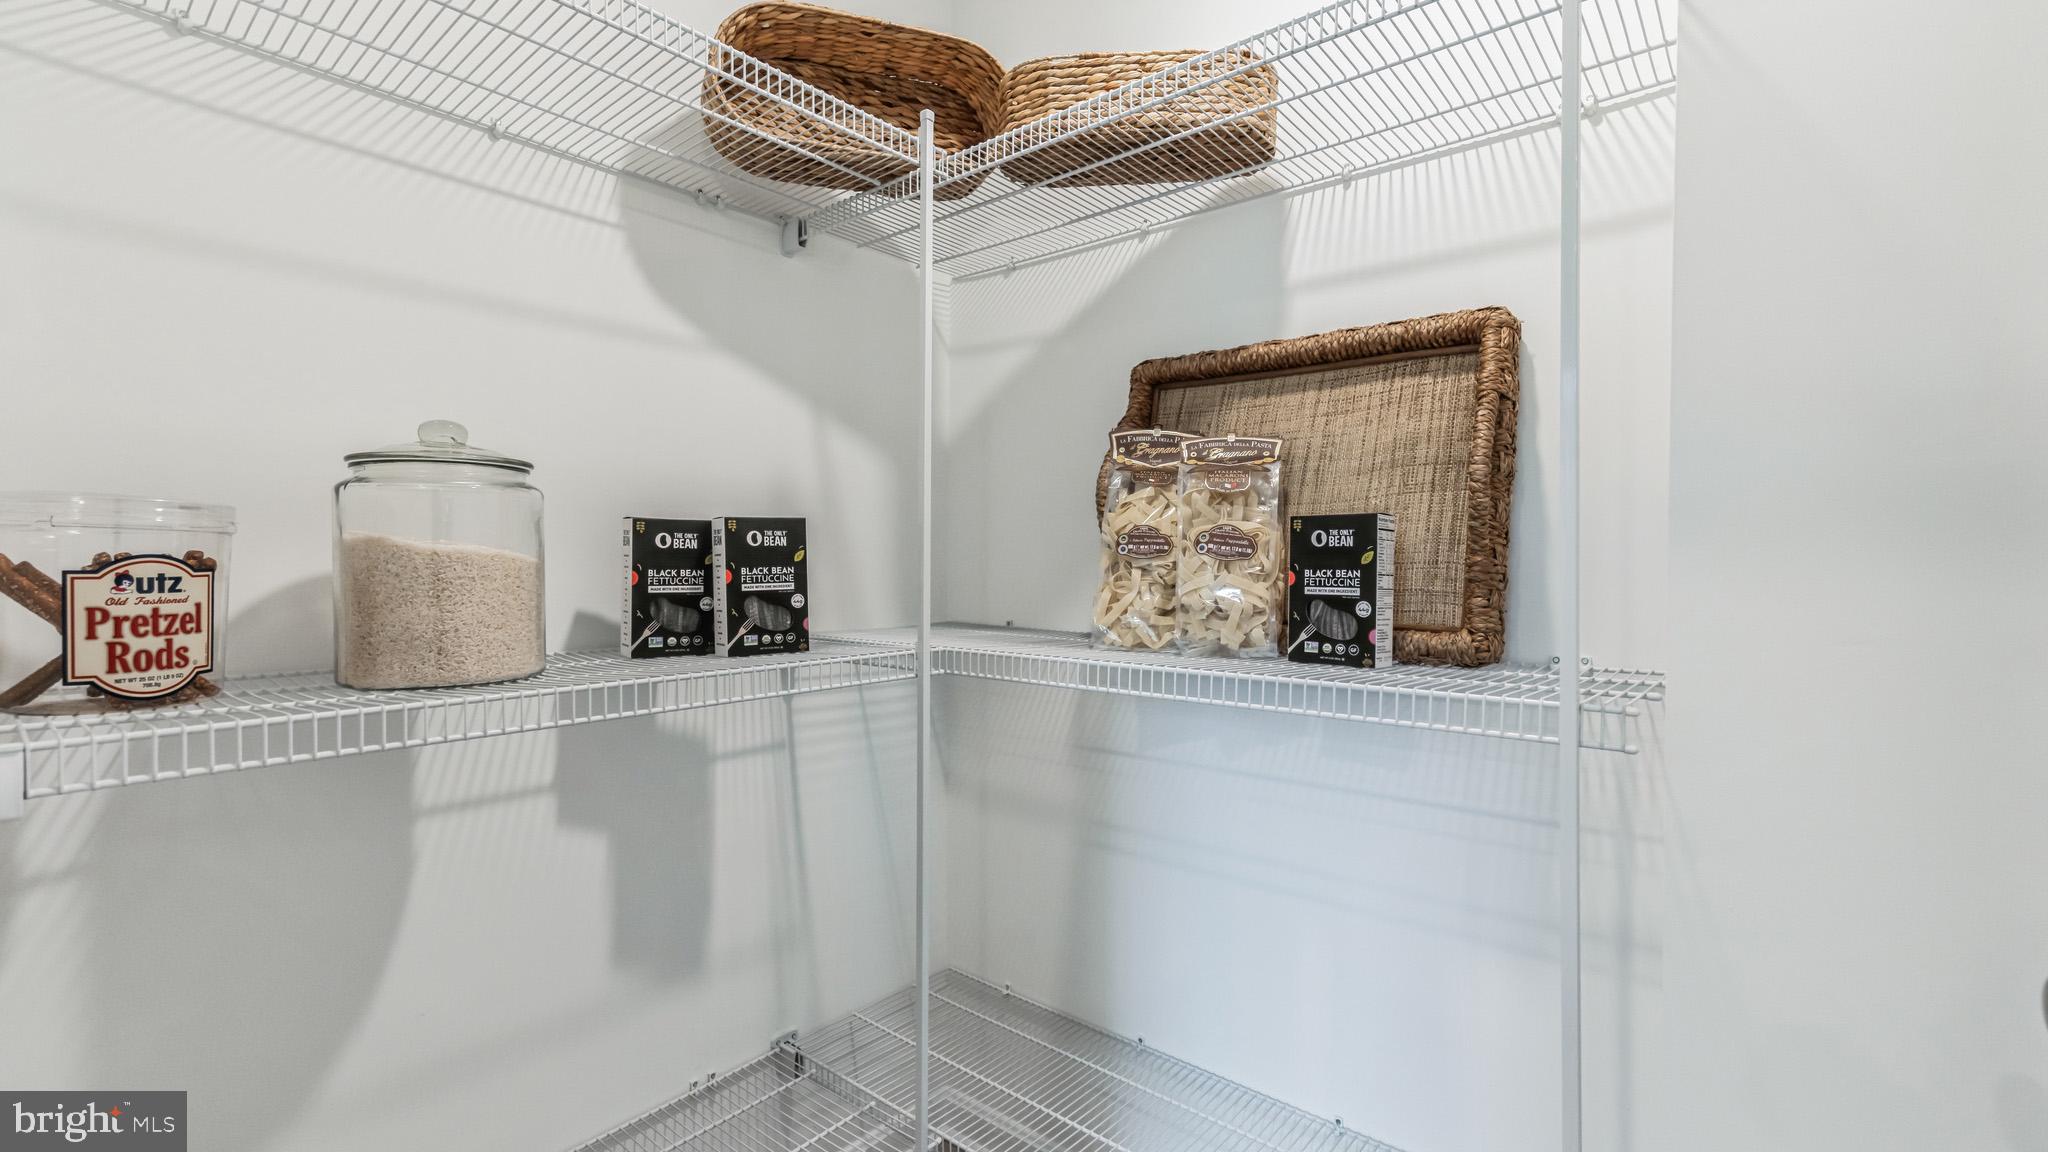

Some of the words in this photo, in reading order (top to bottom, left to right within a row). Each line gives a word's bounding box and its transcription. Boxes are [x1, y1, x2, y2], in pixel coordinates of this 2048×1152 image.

[673, 538, 698, 549] BEAN
[764, 536, 787, 546] BEAN
[1328, 536, 1354, 546] BEAN
[648, 569, 678, 577] BLACK
[680, 569, 704, 577] BEAN
[741, 566, 769, 575] BLACK
[772, 566, 794, 574] BEAN
[1304, 569, 1332, 578] BLACK
[1336, 570, 1360, 578] BEAN
[648, 577, 704, 585] FETTUCCINE
[741, 574, 795, 583] FETTUCCINE
[1304, 578, 1360, 587] FETTUCCINE
[105, 596, 128, 606] Old
[134, 594, 190, 605] Fashioned
[85, 602, 202, 640] Pretzel
[105, 638, 190, 674] Rods
